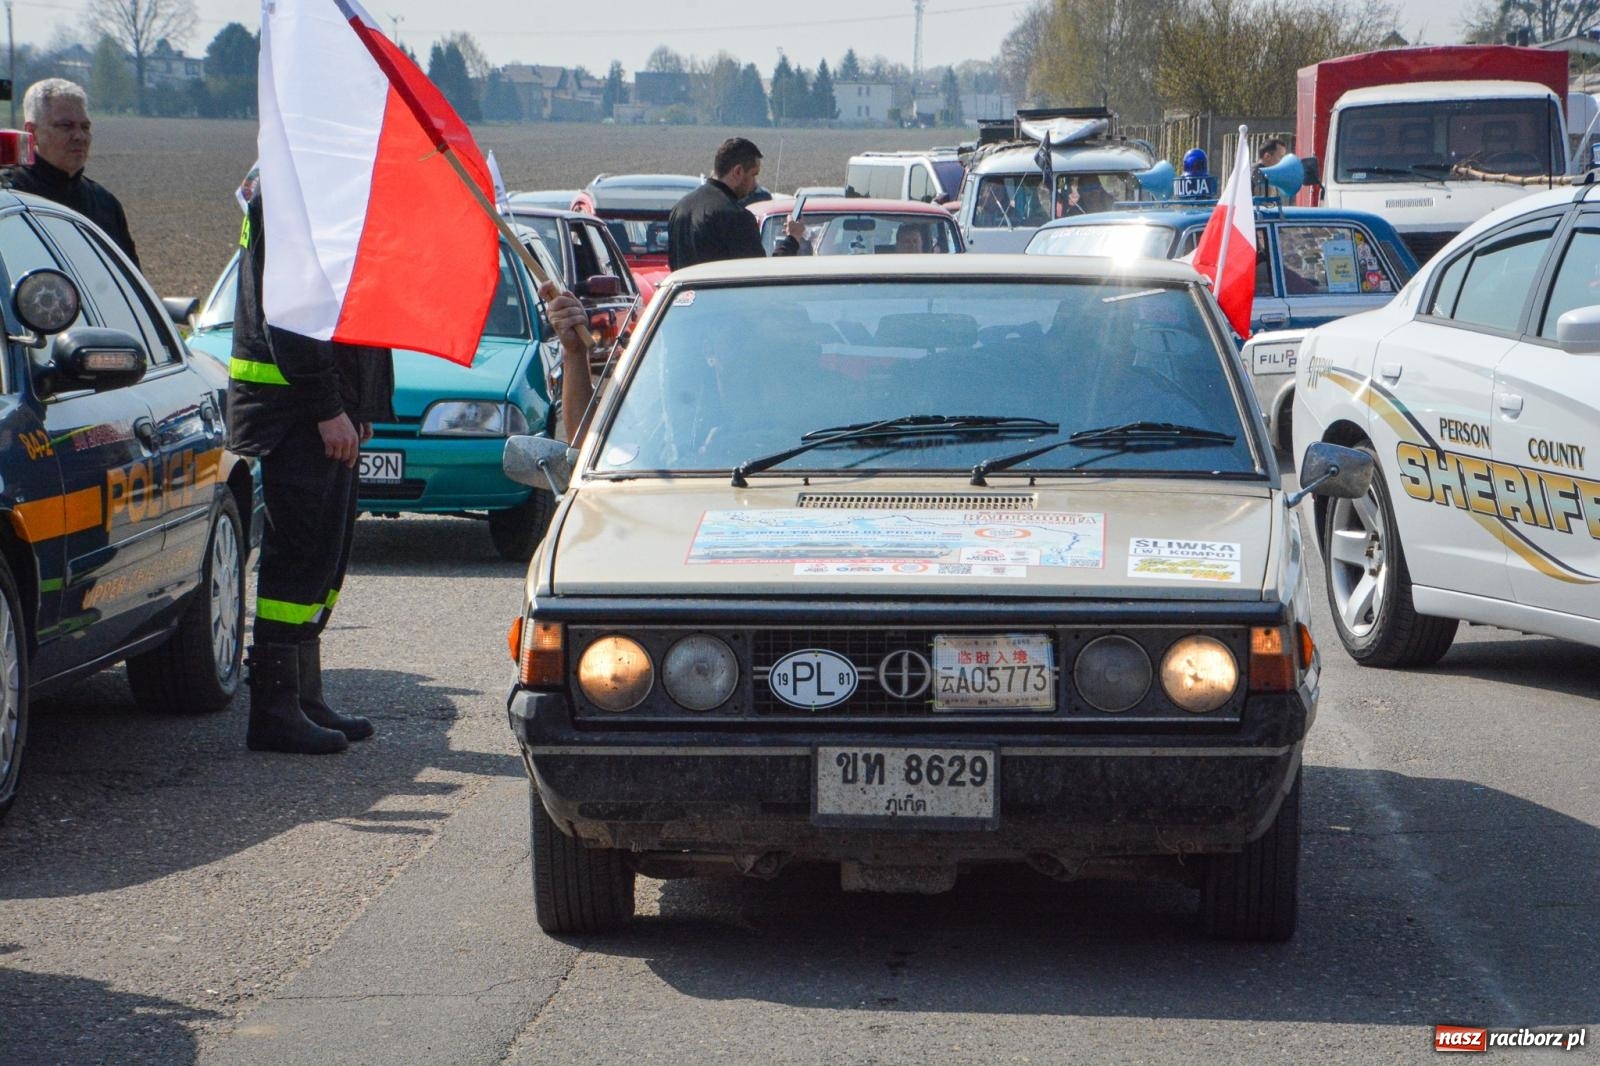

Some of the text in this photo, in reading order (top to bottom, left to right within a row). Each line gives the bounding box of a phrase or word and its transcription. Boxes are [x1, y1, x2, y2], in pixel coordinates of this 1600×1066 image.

[1439, 417, 1586, 471] PERSON COUNTY
[106, 448, 195, 533] POLICE
[1169, 550, 1234, 559] KOMPOT
[958, 649, 1028, 664] 临时入境
[777, 661, 851, 696] 19 PL 81
[904, 754, 988, 787] 8629
